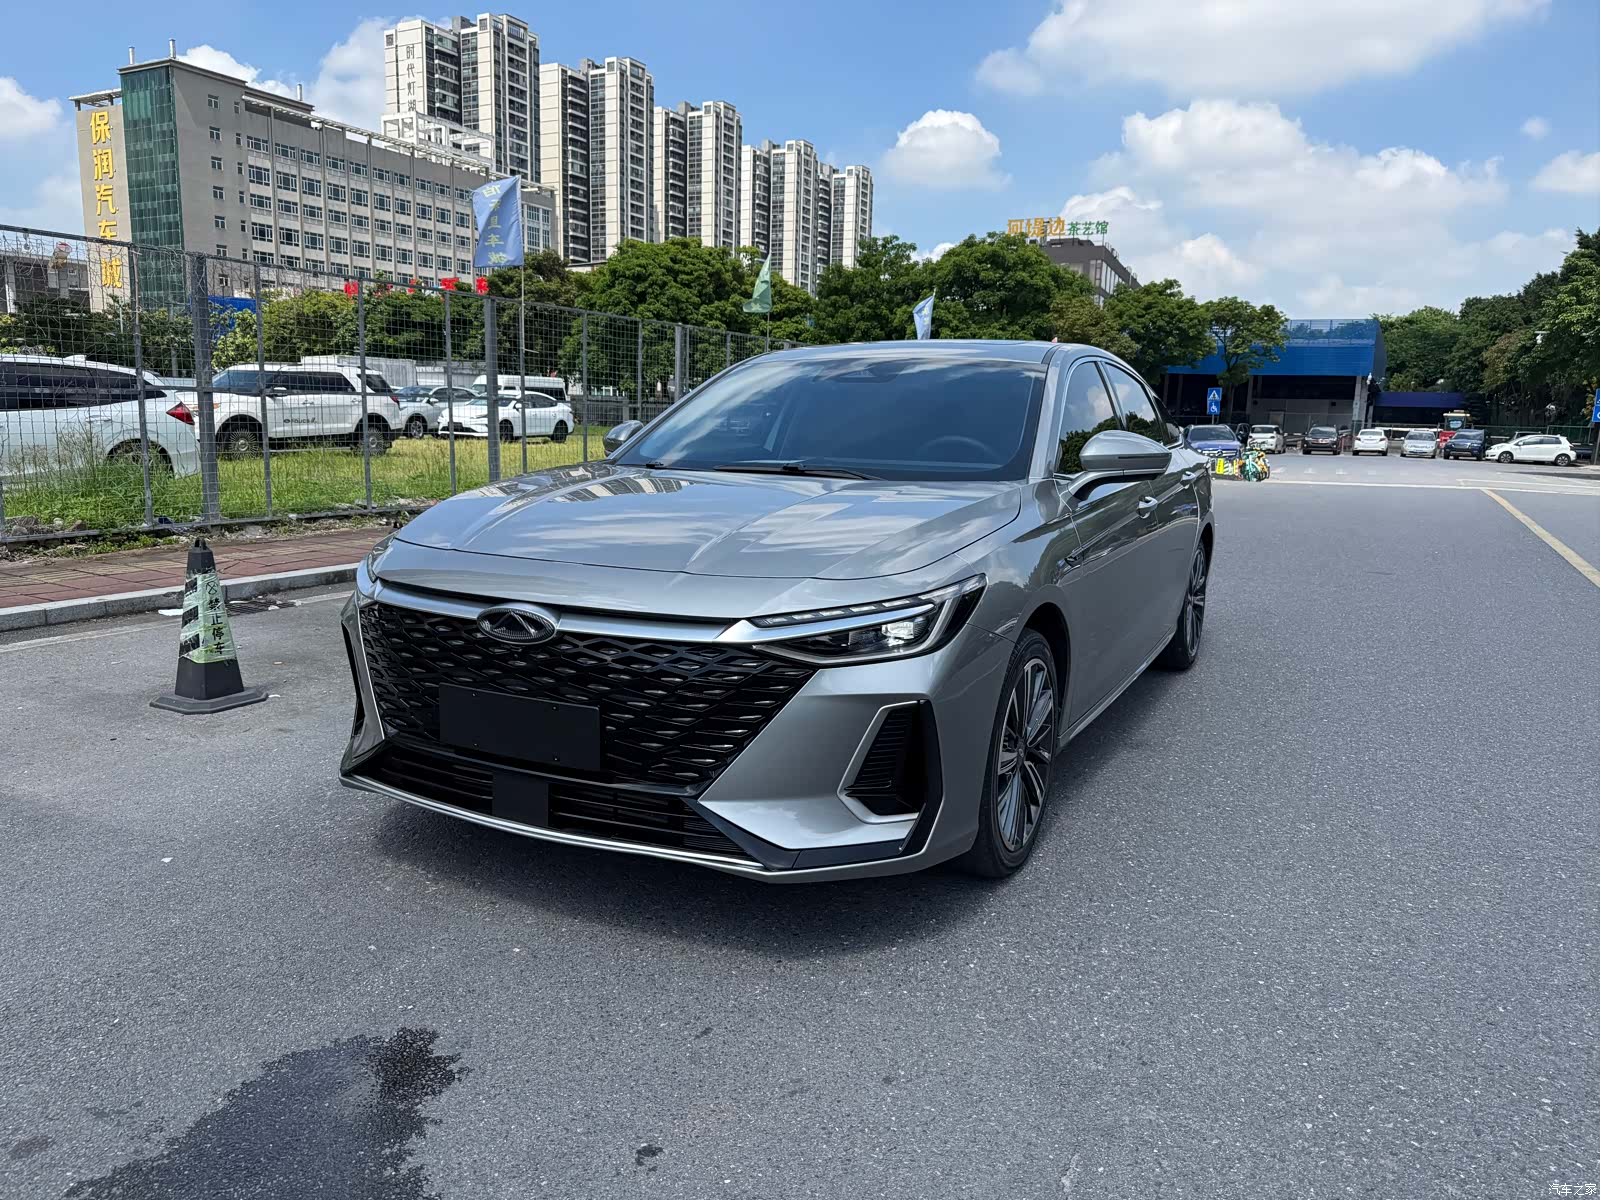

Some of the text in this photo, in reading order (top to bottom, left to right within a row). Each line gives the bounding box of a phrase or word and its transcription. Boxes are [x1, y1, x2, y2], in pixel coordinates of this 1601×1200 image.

[90, 111, 123, 288] 保润汽车城
[208, 597, 225, 655] 禁止停车
